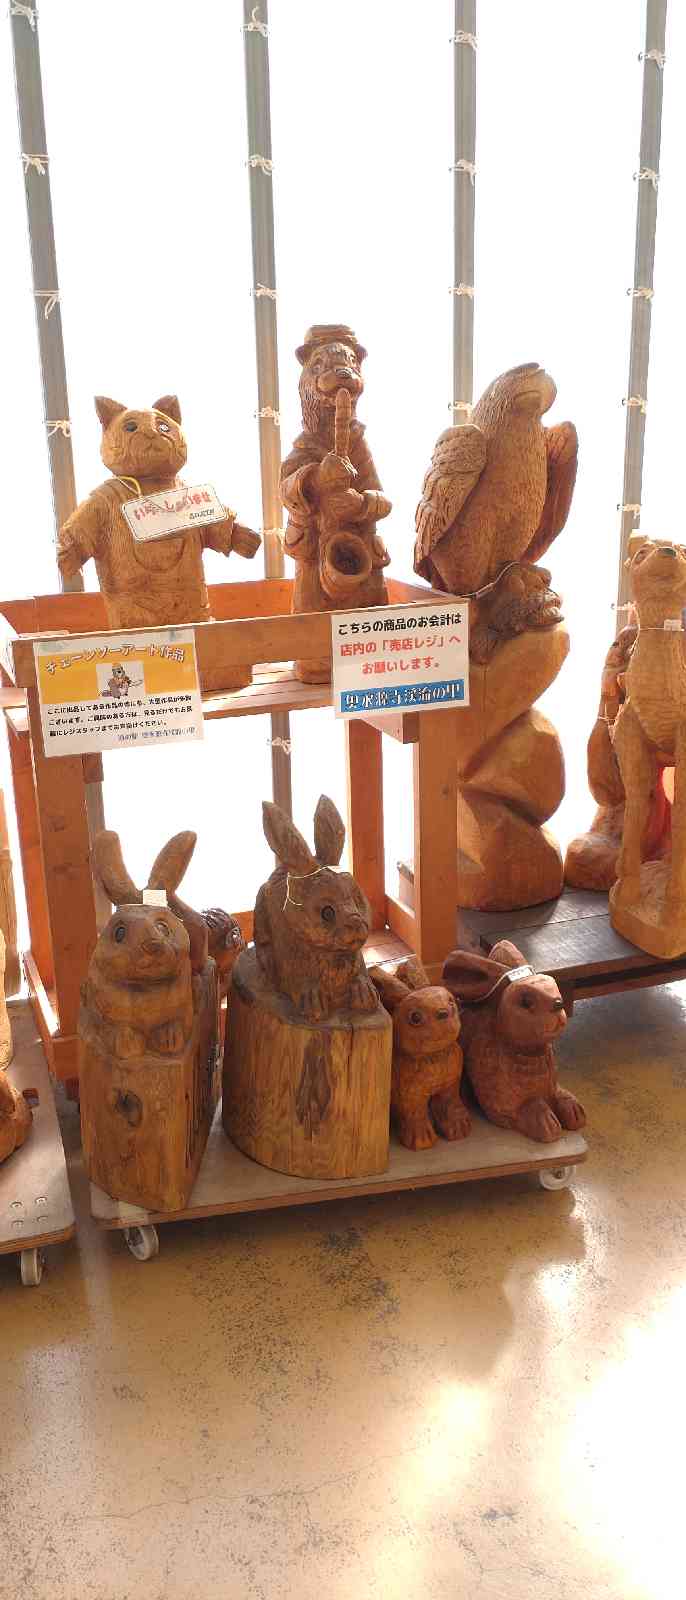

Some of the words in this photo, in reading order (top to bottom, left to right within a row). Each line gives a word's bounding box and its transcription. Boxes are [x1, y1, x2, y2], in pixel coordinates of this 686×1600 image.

[338, 613, 462, 635] こちらの商品のお会計は
[340, 635, 461, 656] 店内の「売店レジ」へ
[46, 643, 185, 675] チェーンソーアート作品
[361, 656, 440, 675] お願いします。
